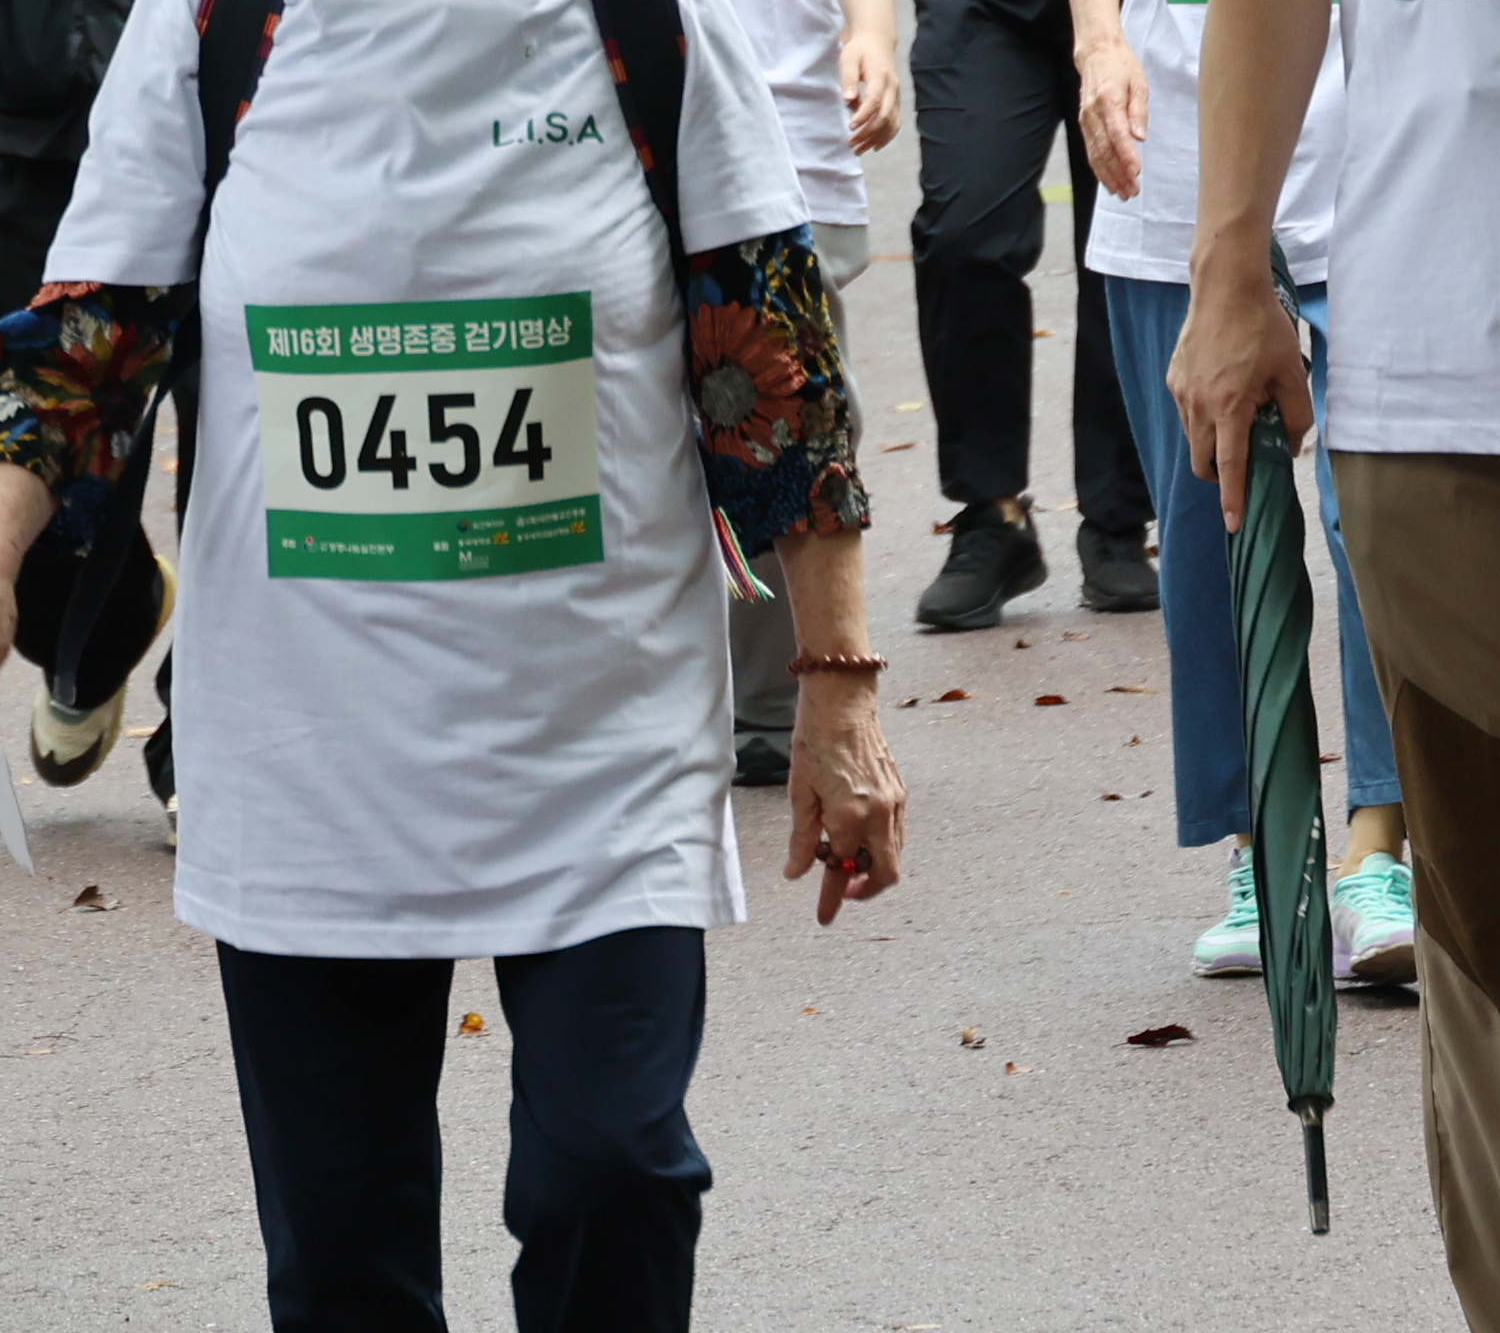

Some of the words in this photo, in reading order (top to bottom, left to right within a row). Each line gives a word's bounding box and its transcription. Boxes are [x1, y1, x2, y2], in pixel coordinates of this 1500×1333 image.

[493, 112, 605, 147] L.I.S.A
[266, 327, 341, 357] 제16회
[350, 323, 457, 357] 생명존중
[464, 315, 573, 353] 걷기명상
[296, 387, 553, 491] 0454
